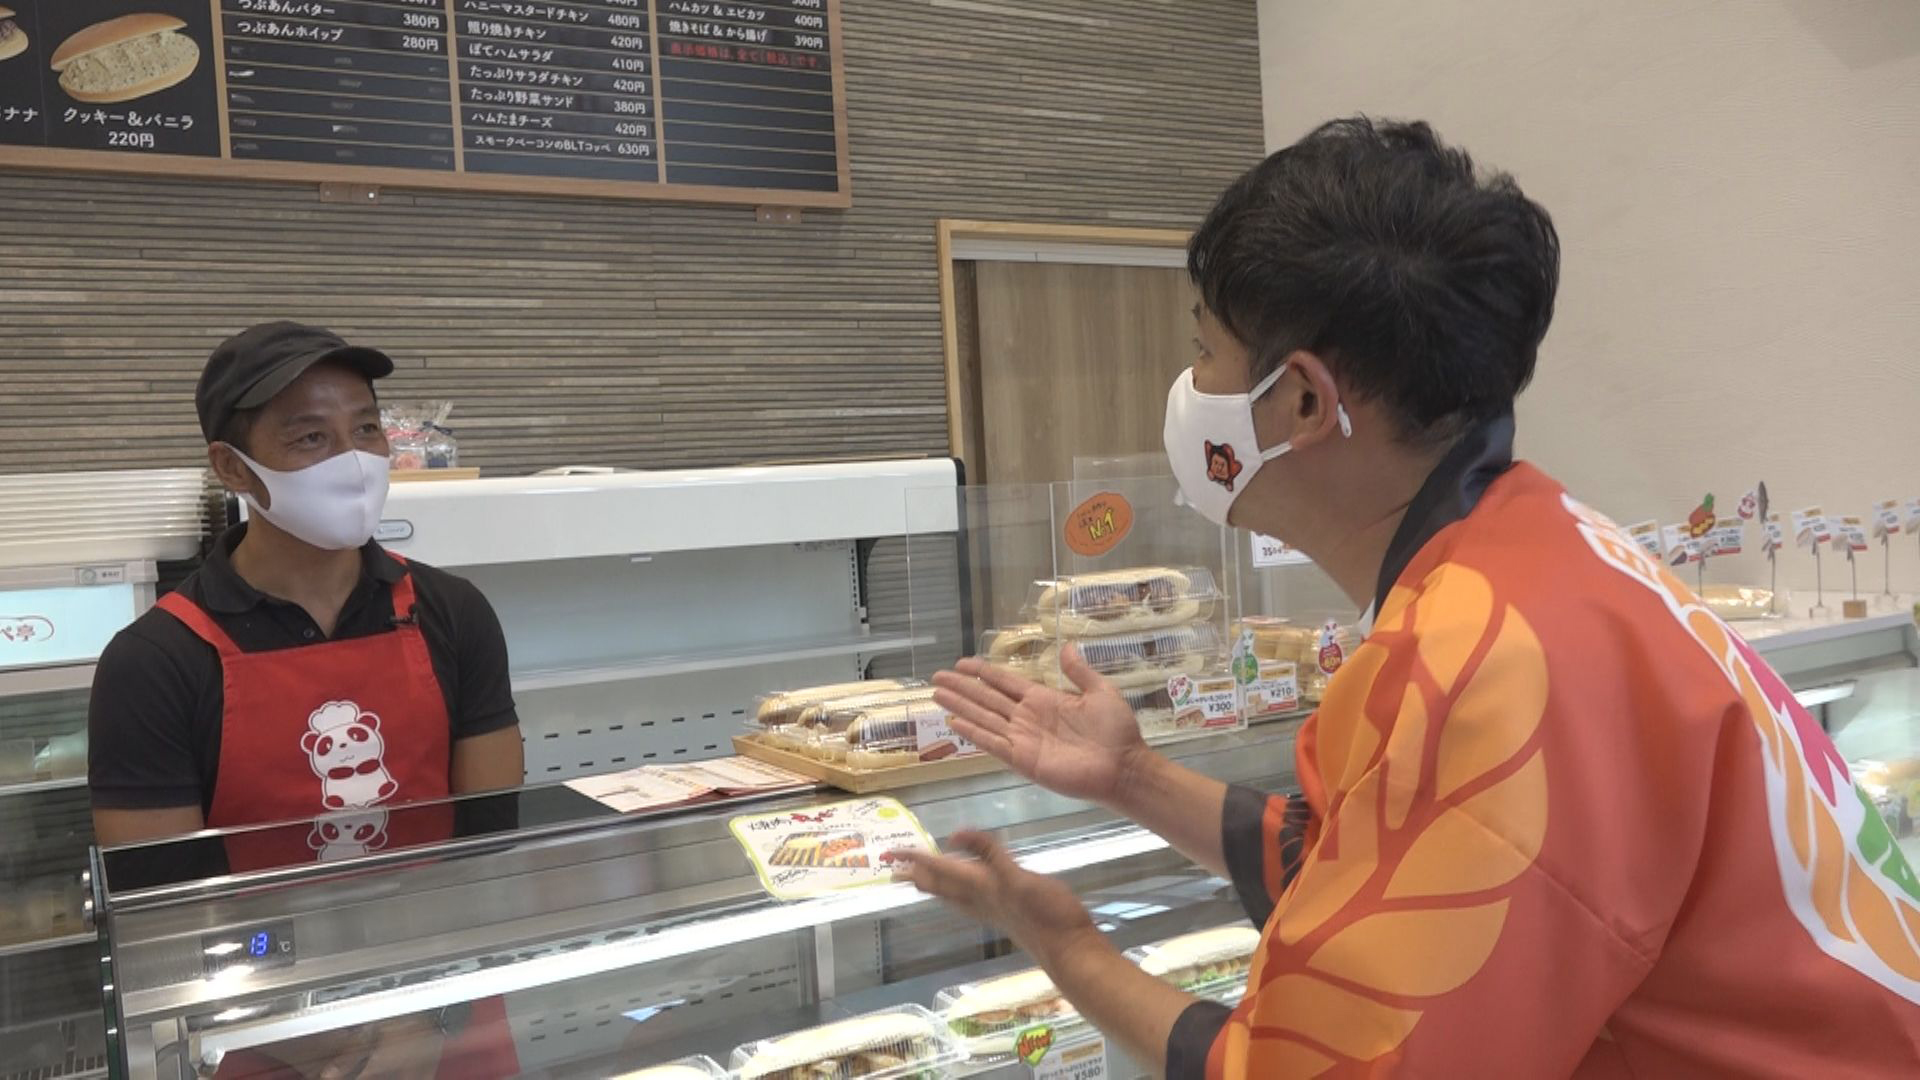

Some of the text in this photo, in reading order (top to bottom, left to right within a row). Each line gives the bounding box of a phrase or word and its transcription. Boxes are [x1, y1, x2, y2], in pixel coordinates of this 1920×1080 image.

[464, 0, 589, 22] ハニーマスタードチキン
[403, 13, 439, 29] 380円
[608, 14, 640, 28] 480円
[794, 15, 823, 29] 400円
[467, 20, 547, 40] 照り焼きチキン
[402, 35, 439, 51] 280円
[610, 35, 643, 50] 420円
[794, 35, 823, 49] 390円
[612, 58, 644, 72] 410円
[470, 65, 584, 87] たっぷりサラダチキン
[613, 79, 645, 93] 420円
[470, 87, 574, 108] たっぷり野菜サンド
[614, 101, 646, 114] 380円
[472, 112, 553, 128] ハムたまチーズ
[615, 123, 647, 136] 420円
[108, 131, 155, 148] 220円
[618, 143, 650, 156] 630円
[251, 932, 269, 956] 13
